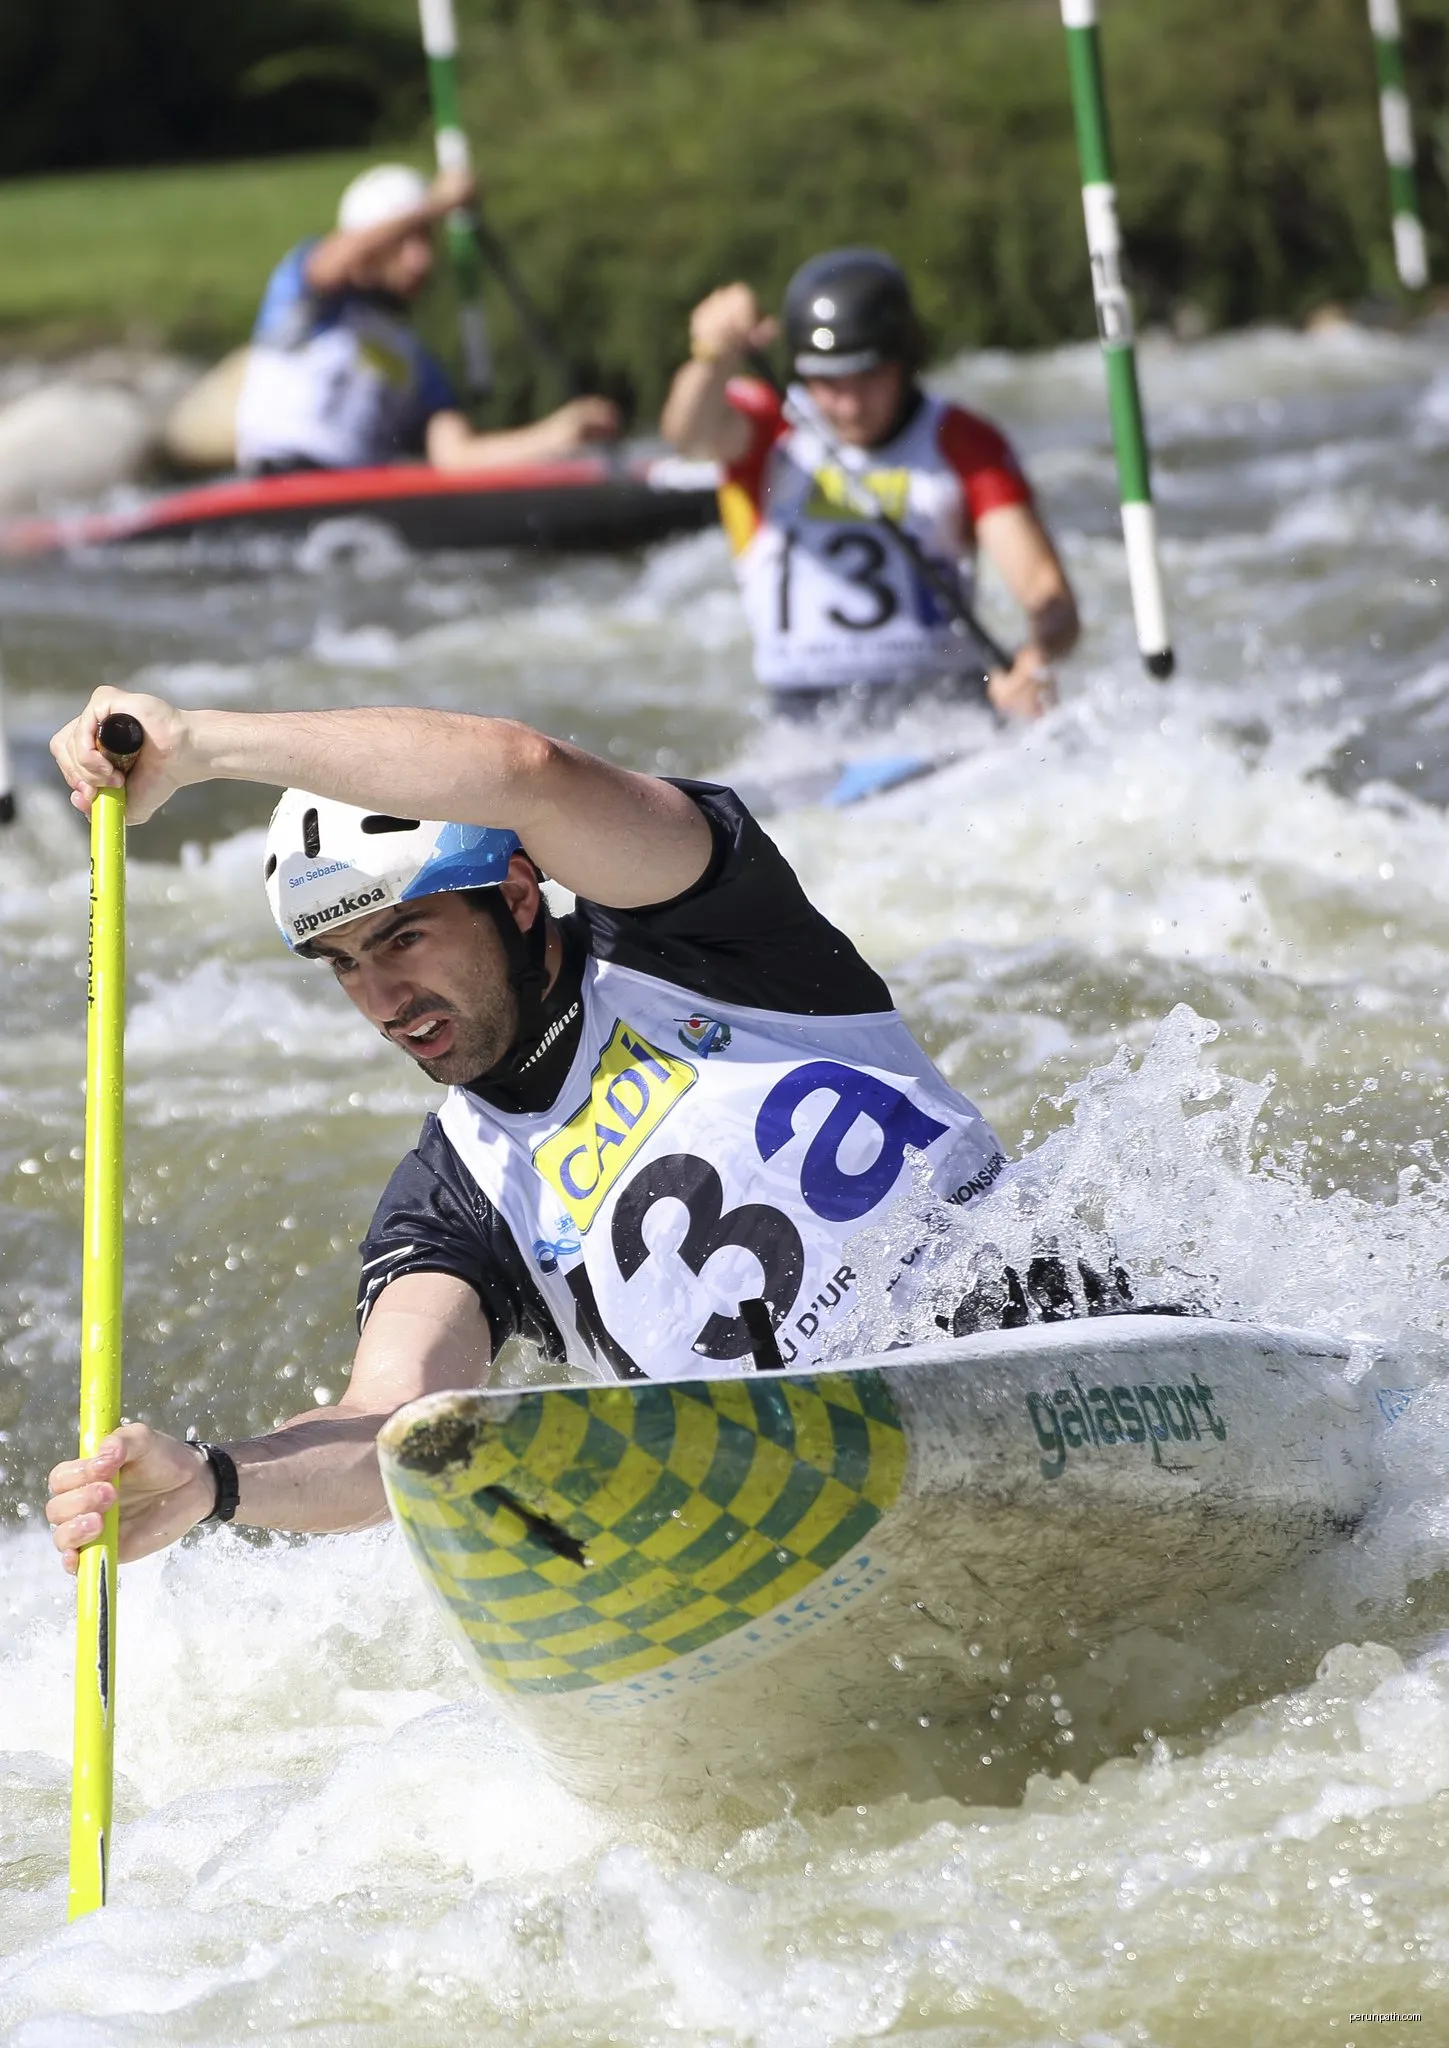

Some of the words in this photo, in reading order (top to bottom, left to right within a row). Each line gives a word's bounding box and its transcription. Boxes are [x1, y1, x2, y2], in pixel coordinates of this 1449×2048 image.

[288, 875, 305, 889] San
[293, 887, 386, 936] gipuzkoa
[560, 1032, 671, 1200] CADÍ
[795, 1265, 857, 1340] D'UR
[1026, 1371, 1227, 1480] galasport
